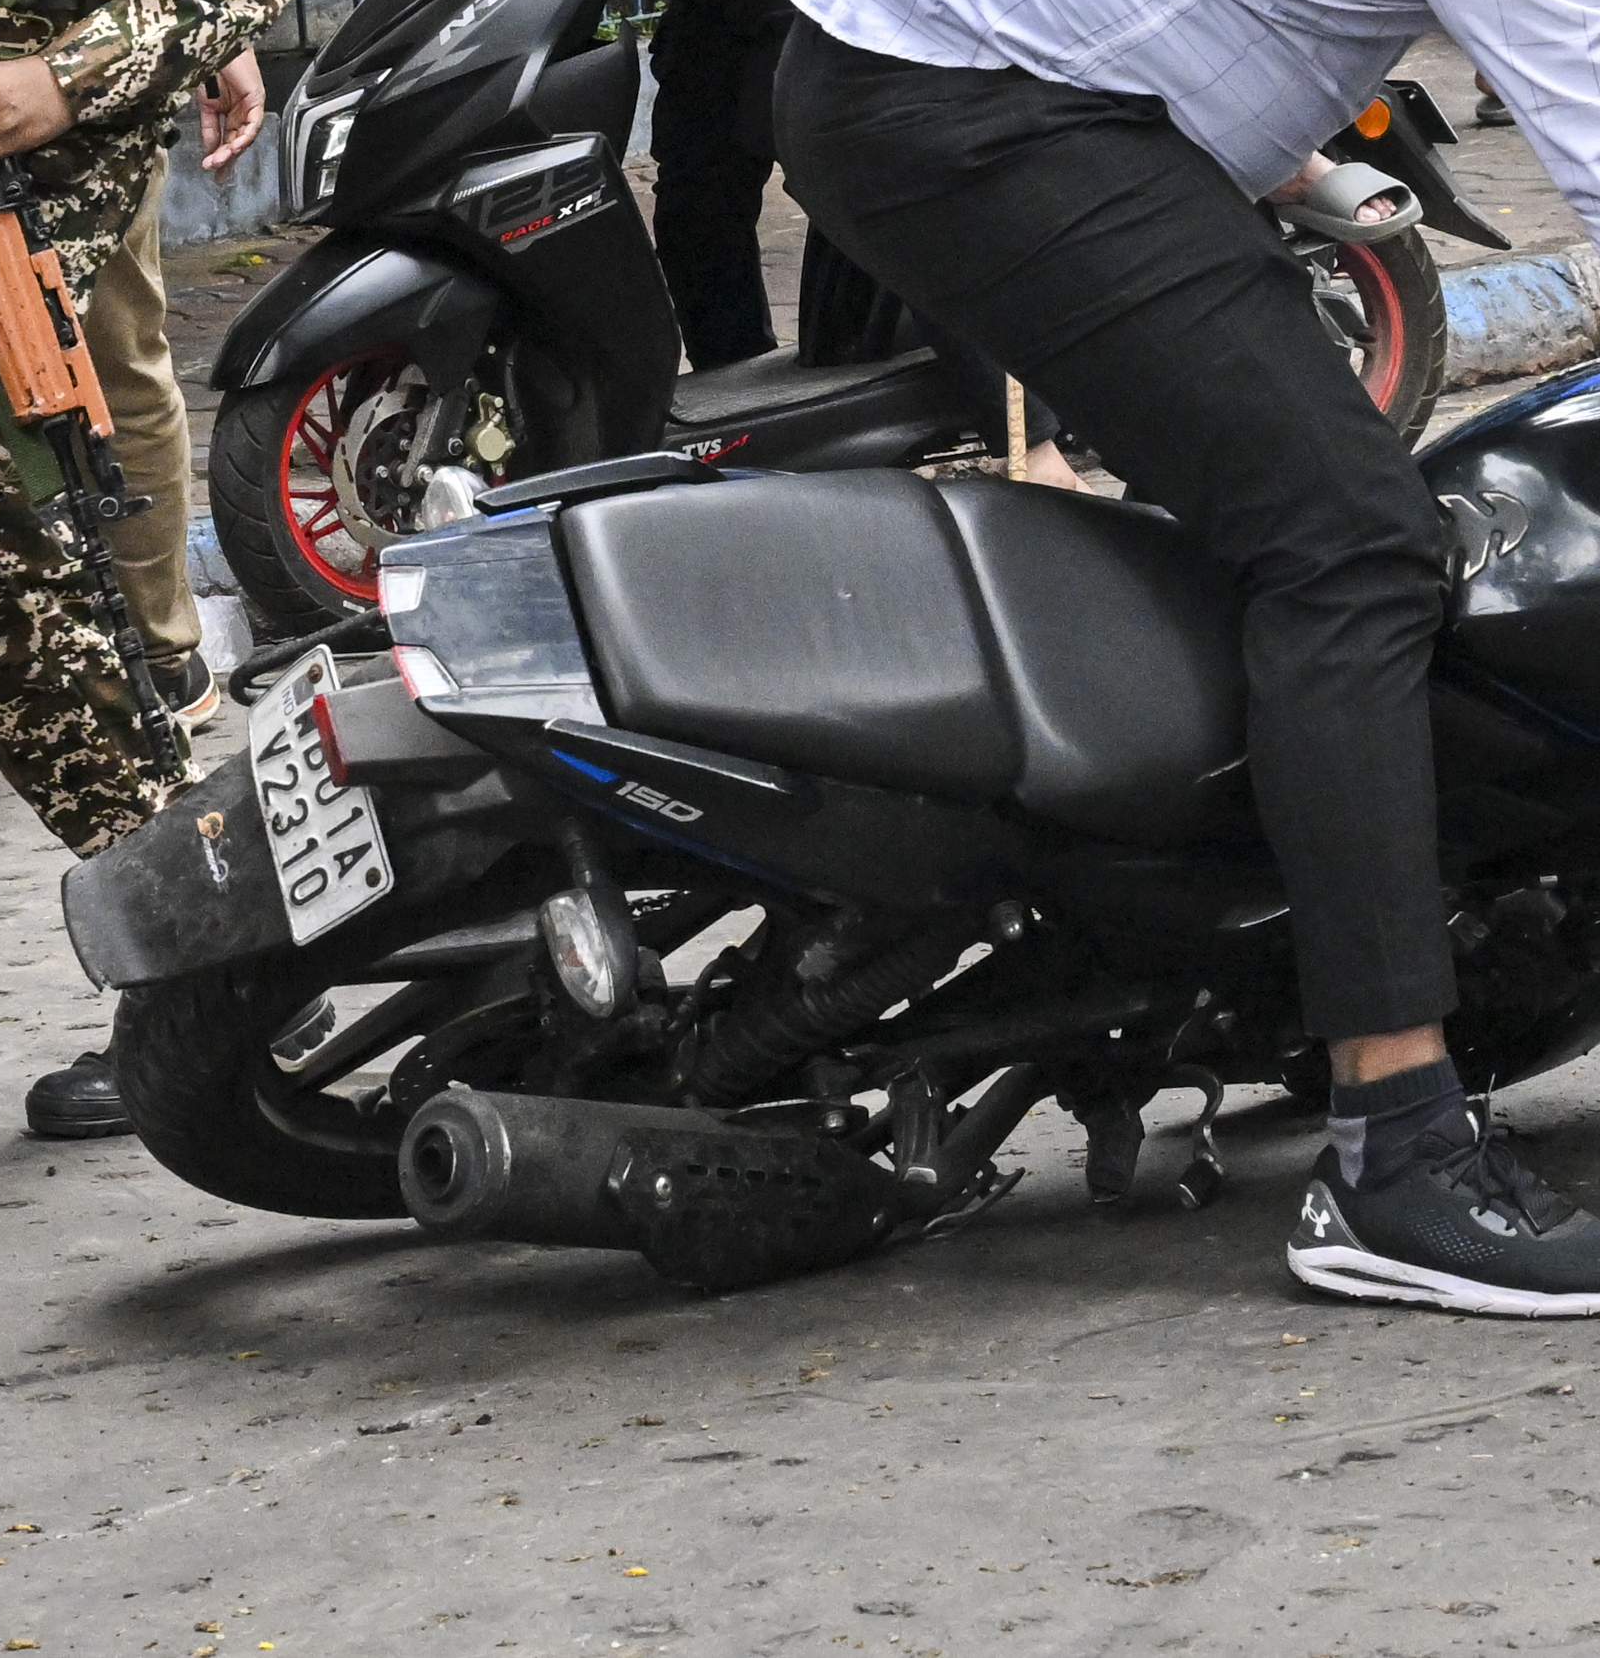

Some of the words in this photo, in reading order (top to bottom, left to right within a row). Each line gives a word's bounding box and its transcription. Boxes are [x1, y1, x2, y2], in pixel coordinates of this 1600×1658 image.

[499, 213, 555, 243] RACE
[681, 438, 723, 461] TVS
[280, 686, 295, 717] IND
[256, 726, 329, 907] V2310
[615, 781, 704, 823] 150
